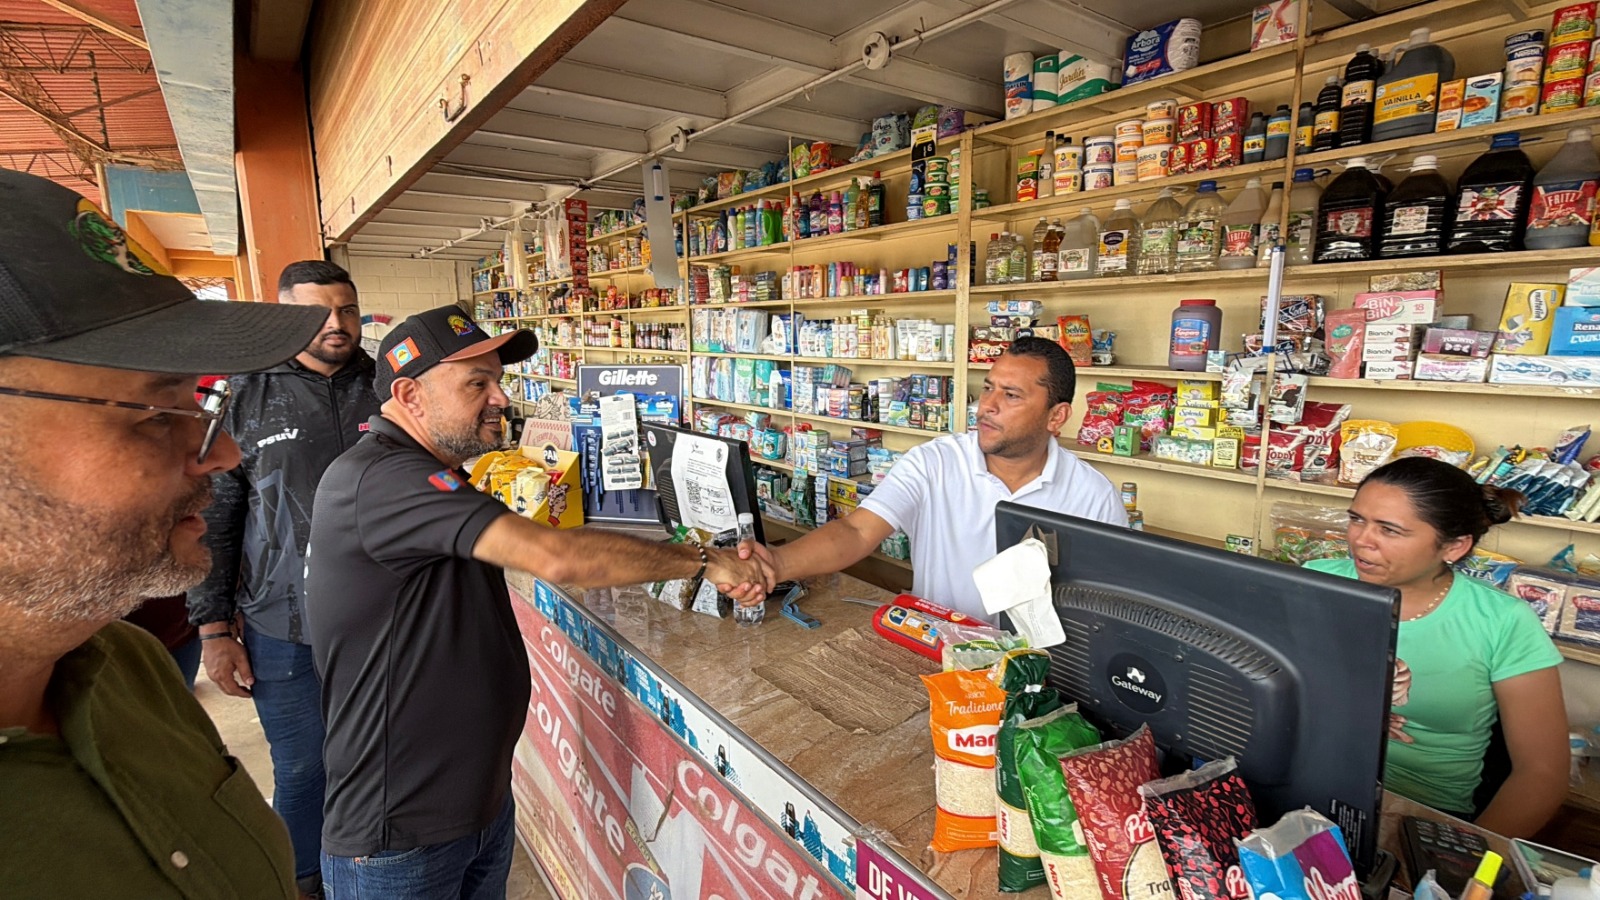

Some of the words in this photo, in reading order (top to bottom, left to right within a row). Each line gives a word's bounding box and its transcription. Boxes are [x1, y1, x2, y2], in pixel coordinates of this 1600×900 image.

[1131, 34, 1161, 50] Arbora
[1383, 92, 1421, 107] VAINILLA
[1548, 192, 1577, 207] FRITZ
[1574, 322, 1600, 331] Rena
[599, 369, 658, 386] Gillette
[1306, 430, 1335, 446] DDY
[543, 449, 558, 462] PAN
[540, 626, 616, 718] Colgate
[1111, 675, 1163, 703] Gateway
[946, 700, 1005, 717] Tradiciona
[955, 733, 997, 748] Mar
[677, 759, 823, 900] Colgat
[868, 860, 893, 900] DE
[1048, 863, 1063, 898] Mary
